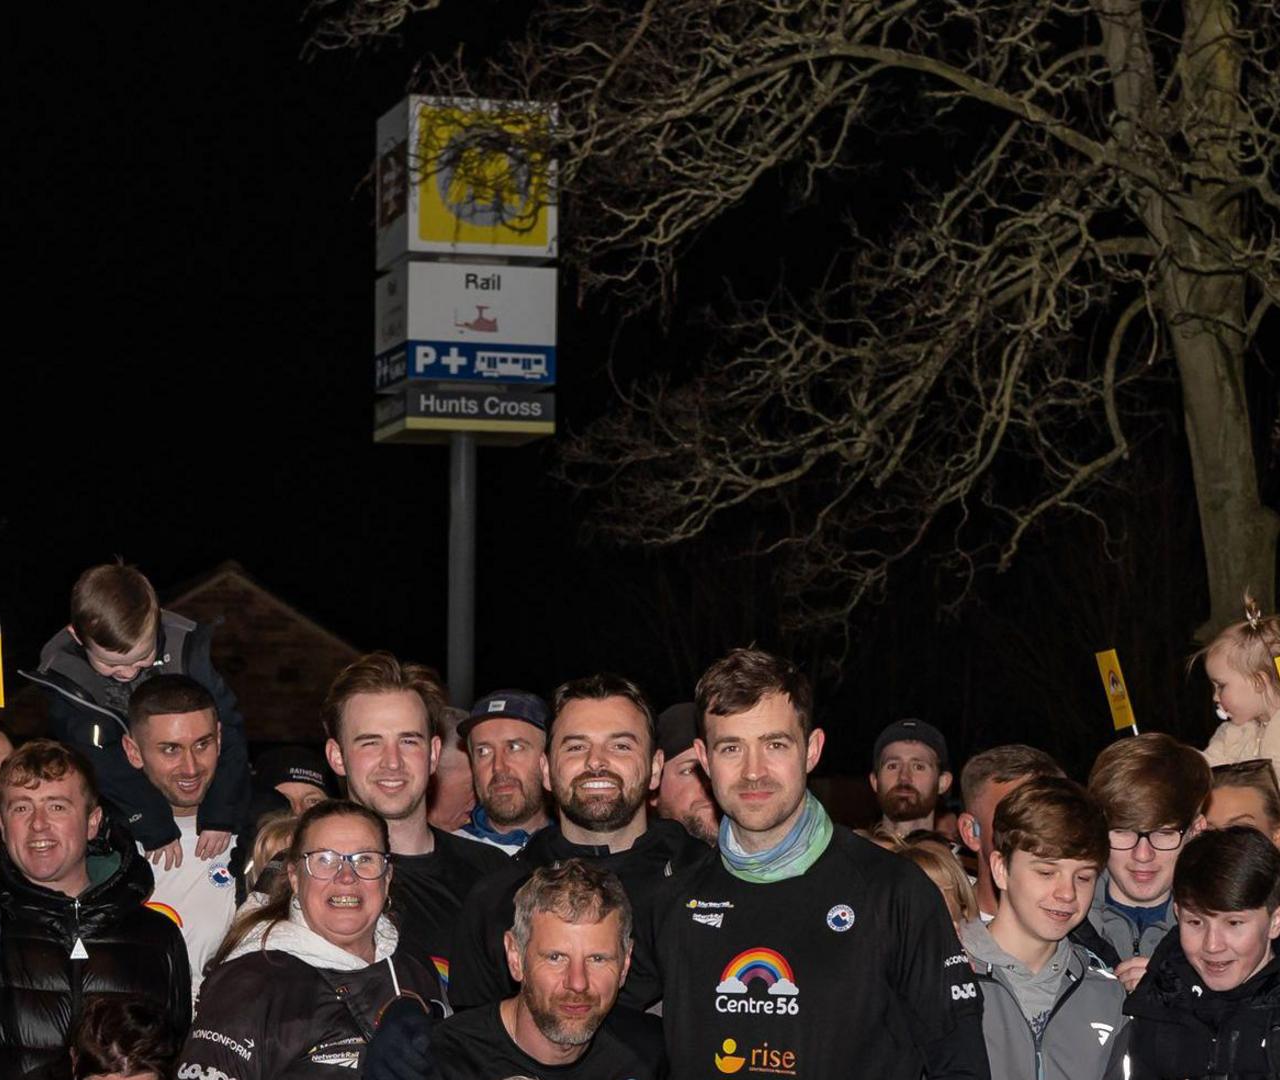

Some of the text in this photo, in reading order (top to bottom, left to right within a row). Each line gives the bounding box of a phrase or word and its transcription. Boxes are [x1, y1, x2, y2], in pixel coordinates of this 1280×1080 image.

[465, 273, 501, 290] Rail
[419, 394, 542, 416] Hunts Cross
[715, 995, 799, 1015] Centre 56
[751, 1042, 796, 1068] rise
